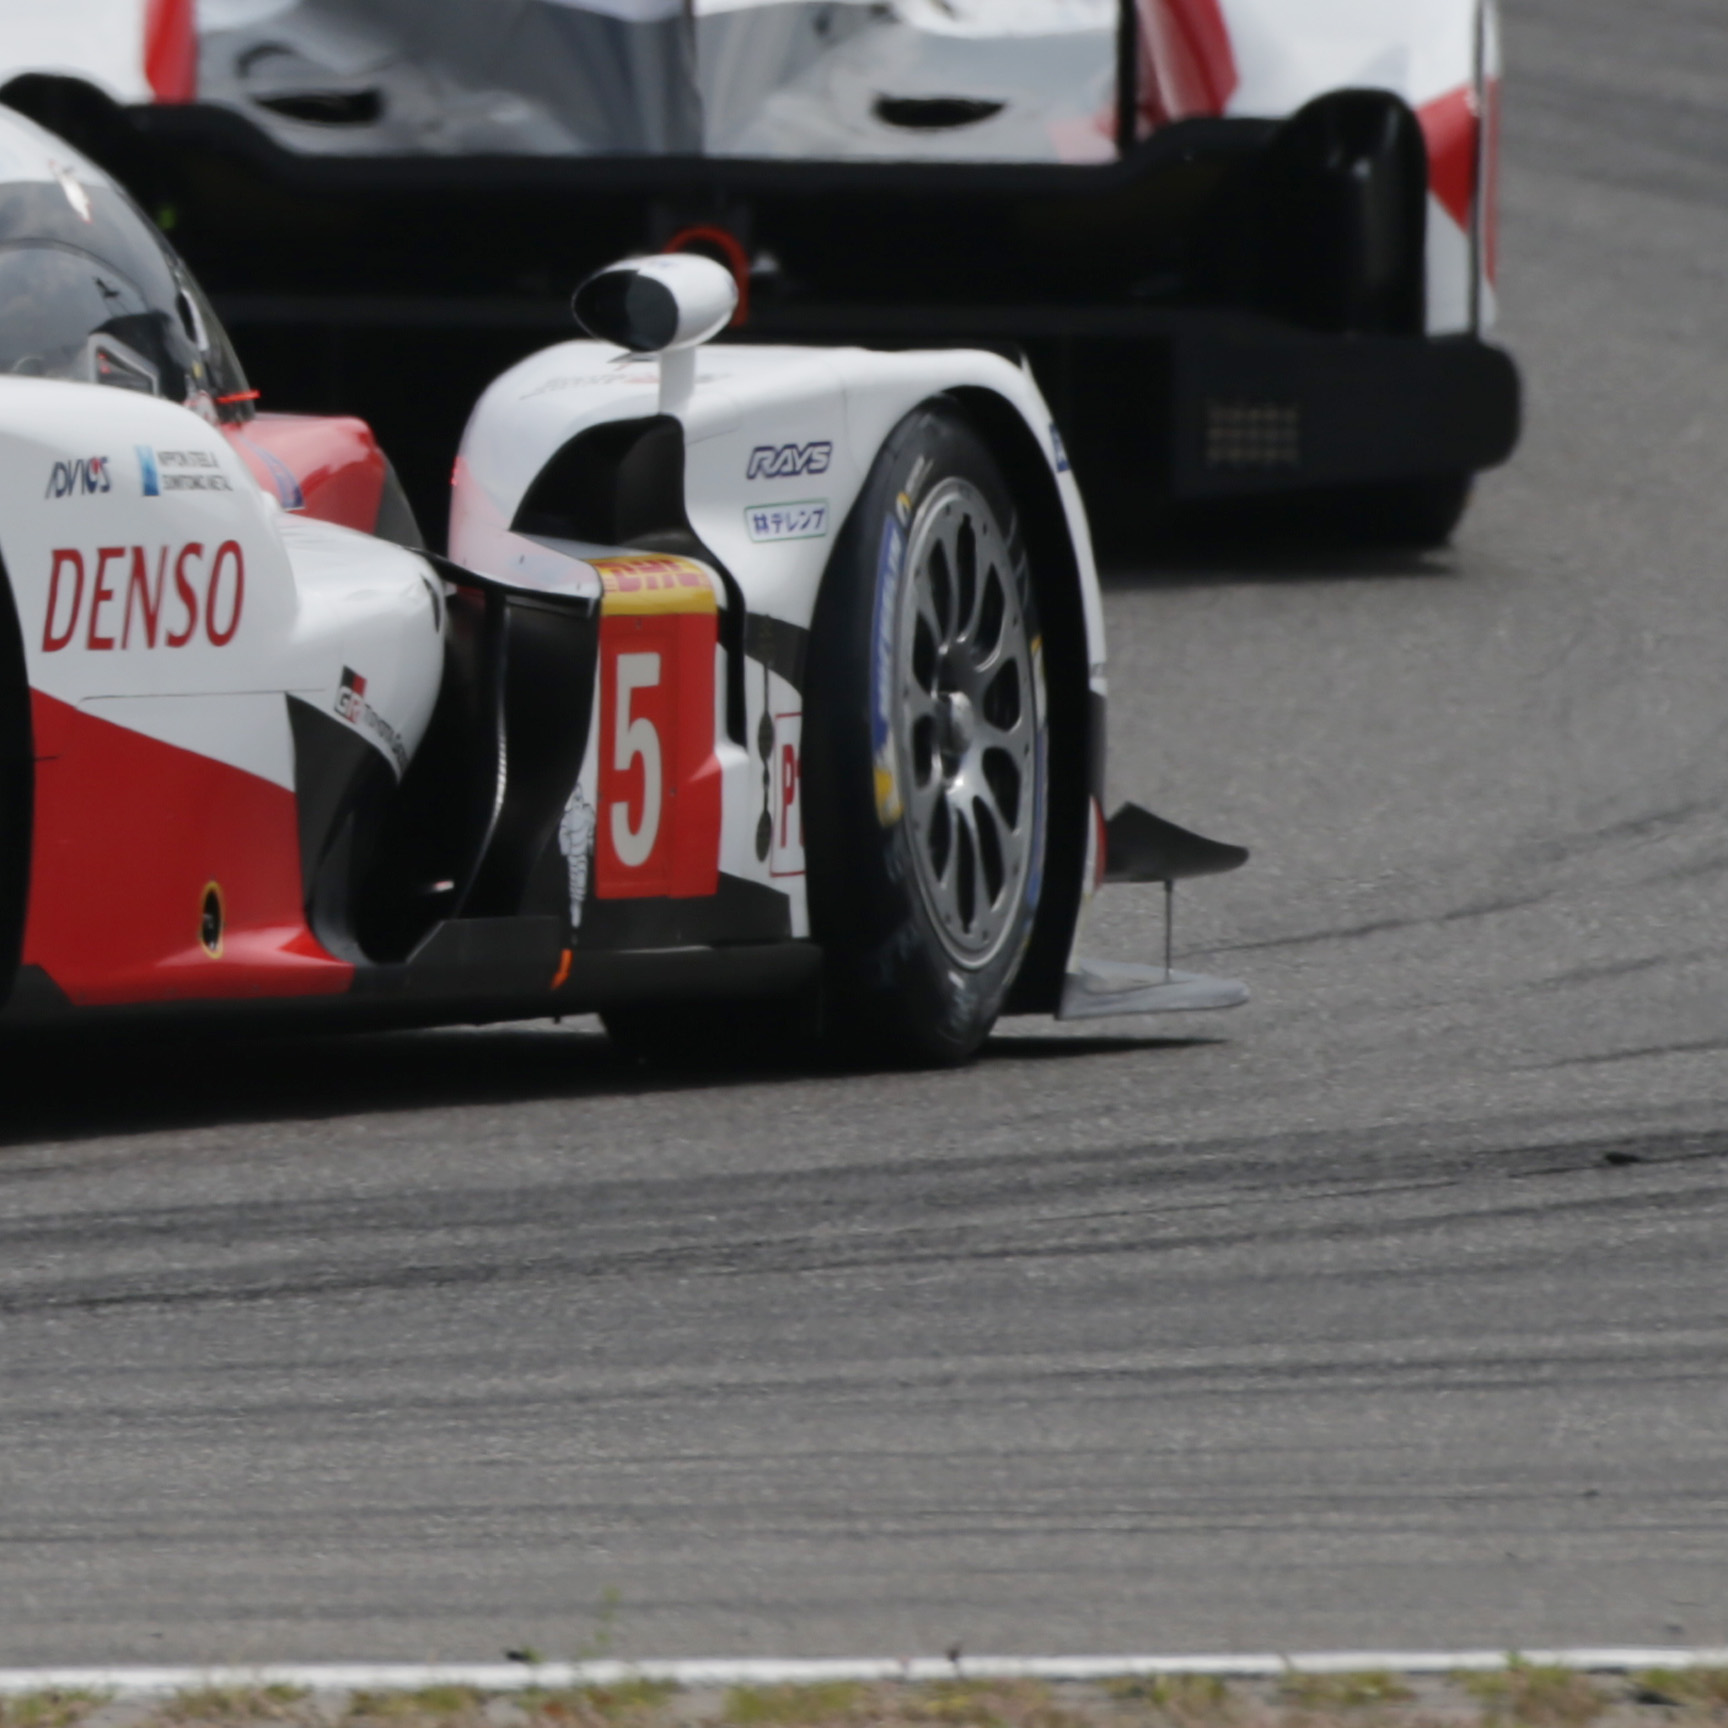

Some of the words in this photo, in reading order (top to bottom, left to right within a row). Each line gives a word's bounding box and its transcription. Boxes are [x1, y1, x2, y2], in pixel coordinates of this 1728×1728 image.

[746, 440, 833, 480] RAYS
[41, 539, 245, 653] DENSO
[610, 651, 662, 867] 5
